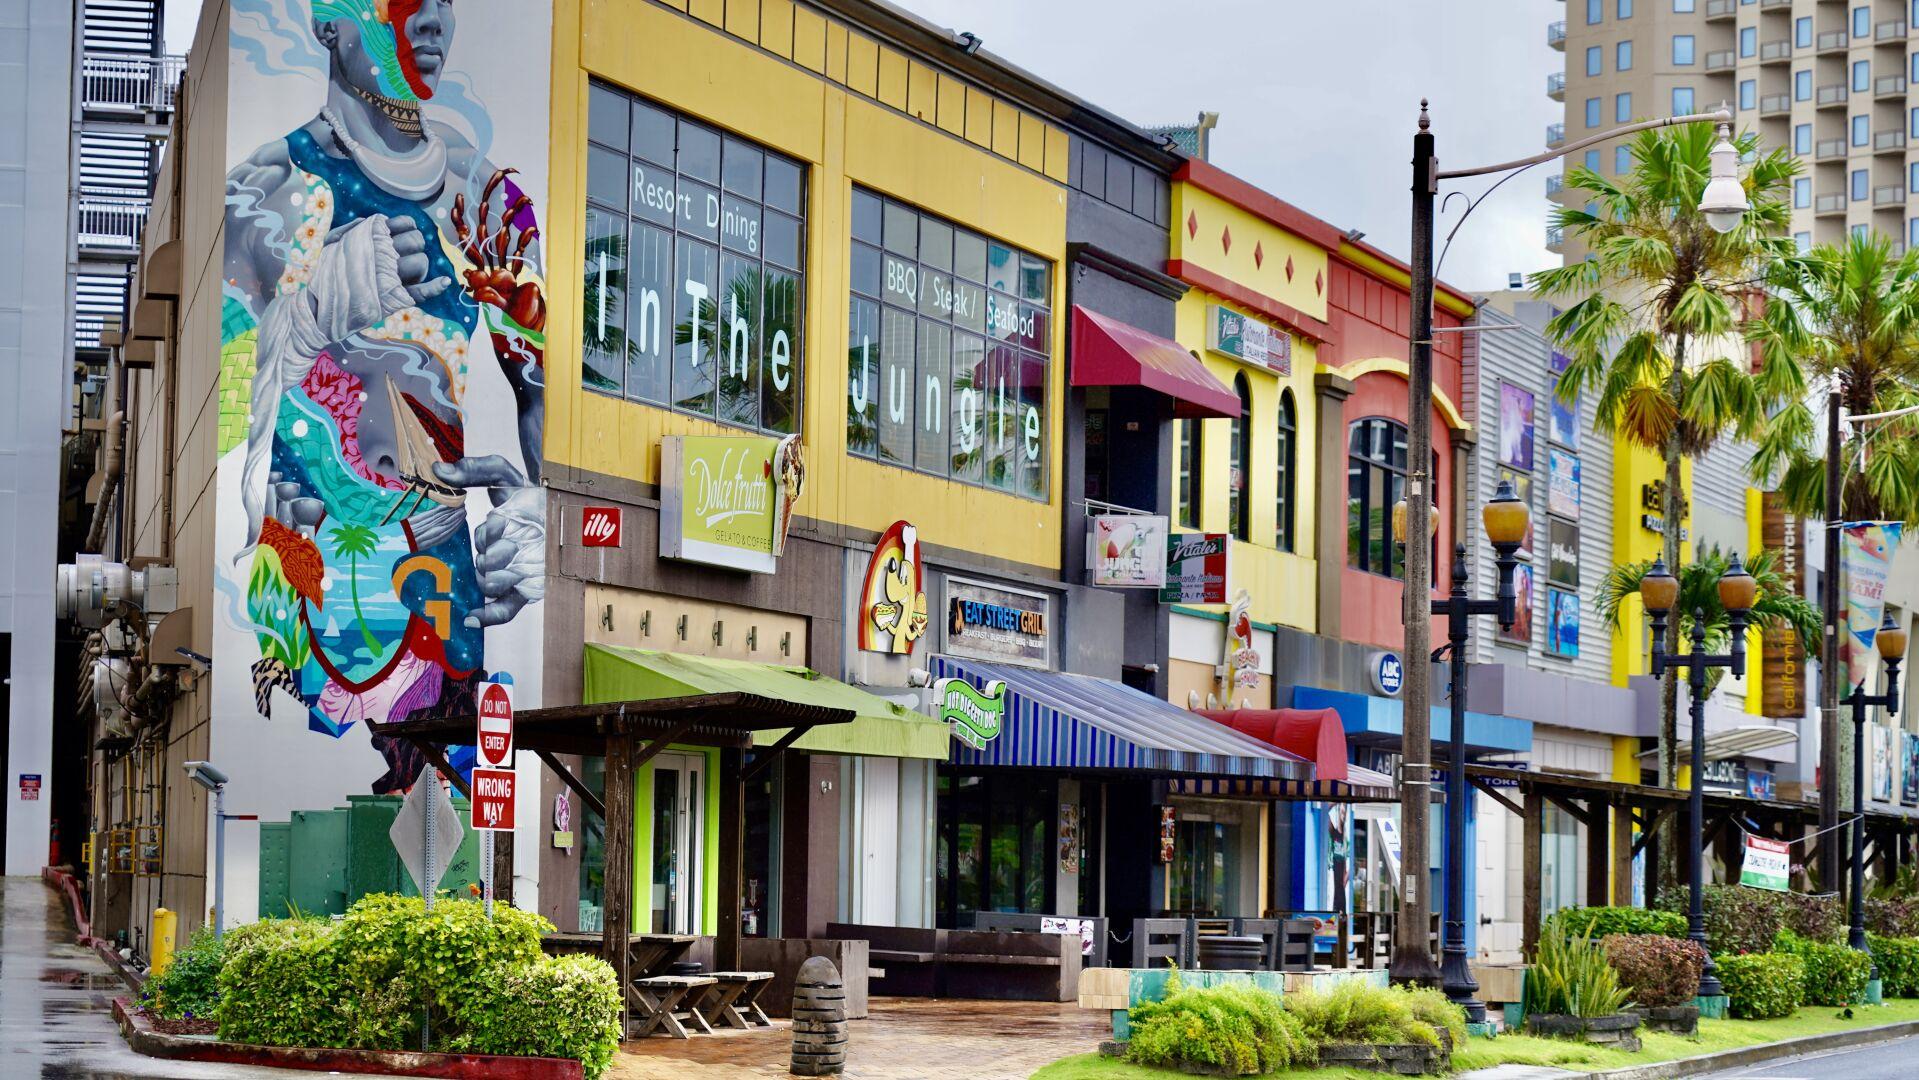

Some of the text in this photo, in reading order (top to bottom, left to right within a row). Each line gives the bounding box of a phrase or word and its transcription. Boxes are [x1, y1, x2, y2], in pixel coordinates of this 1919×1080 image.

[633, 166, 758, 253] Resort Dining
[987, 295, 1035, 339] Seafood
[852, 335, 1040, 460] Jungle
[689, 448, 732, 516] Dolce
[583, 512, 617, 542] illy
[1784, 513, 1795, 574] KITCHE
[1173, 540, 1218, 562] Vitale's
[965, 600, 1047, 636] EAT STREET GRILL
[1381, 660, 1400, 678] ABC
[484, 699, 507, 715] DO NOT
[947, 690, 960, 711] HOT
[984, 710, 997, 729] DOG
[485, 735, 505, 751] ENTER
[477, 777, 512, 799] WRONG
[483, 802, 504, 822] WAY
